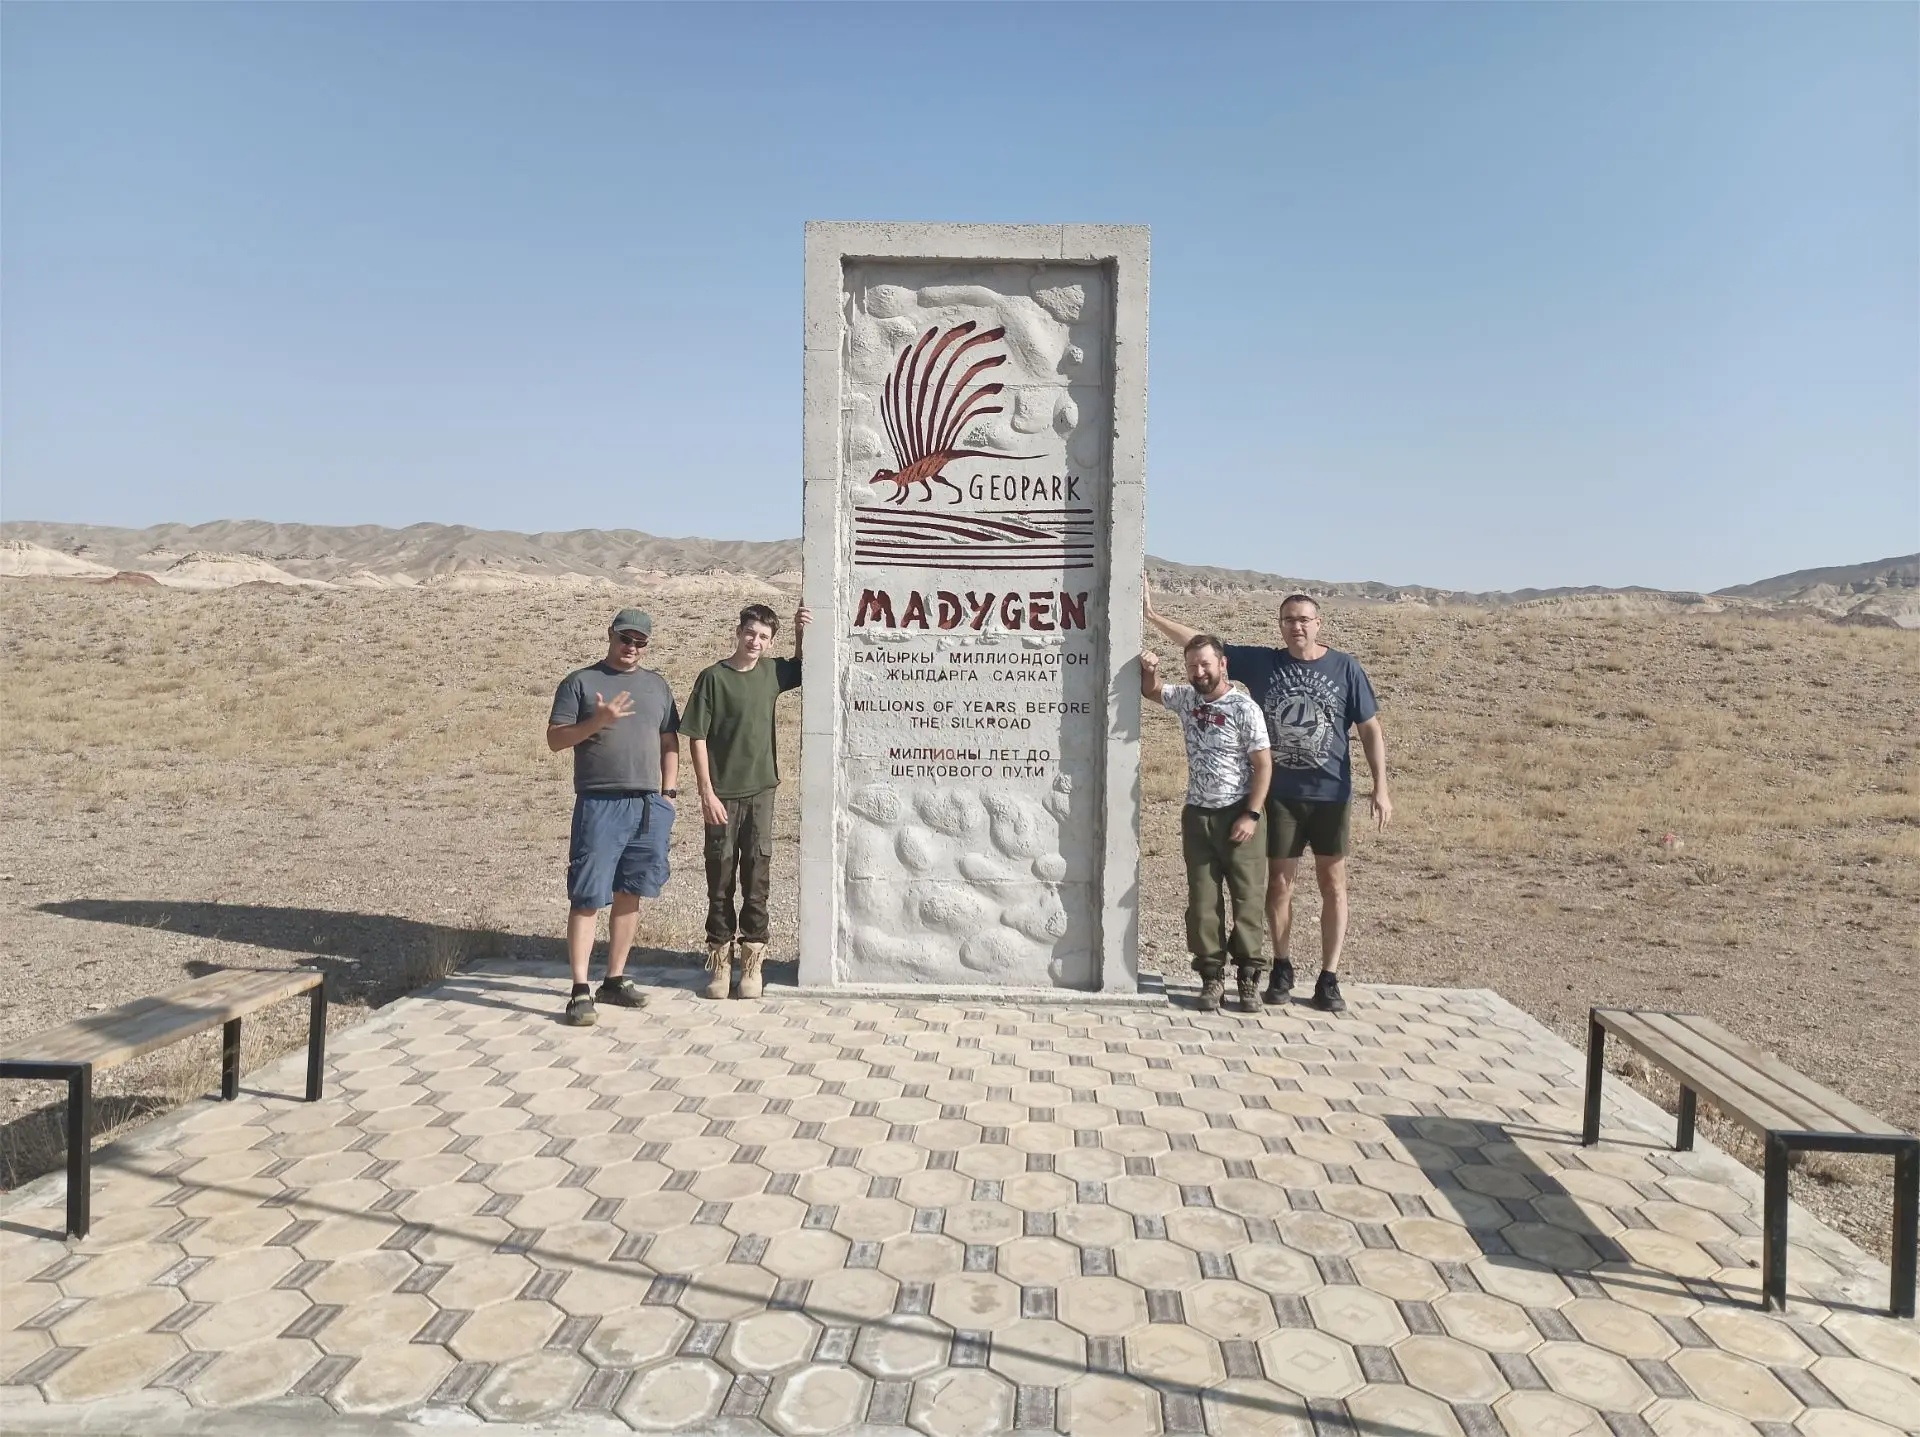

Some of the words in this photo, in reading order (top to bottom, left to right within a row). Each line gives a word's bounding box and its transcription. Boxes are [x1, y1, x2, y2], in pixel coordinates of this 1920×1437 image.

[969, 474, 1081, 501] GEOPARK
[853, 588, 1088, 631] MADYGEN
[854, 646, 934, 663] БАЙЫРКЫ
[949, 652, 1089, 666] МИЛЛИОНДОГОН
[886, 668, 978, 682] ЖЫЛДАРГА
[993, 669, 1058, 682] САЯКАТ
[854, 700, 925, 713] MILLIONS
[933, 701, 953, 713] OF
[963, 701, 1016, 713] YEARS
[1026, 702, 1091, 714] BEFORE
[911, 716, 939, 729] THE
[951, 717, 1031, 729] SILKROAD
[989, 749, 1020, 761] ЛЕТ
[1027, 749, 1050, 763] ДО
[1003, 766, 1044, 778] ПУТИ
